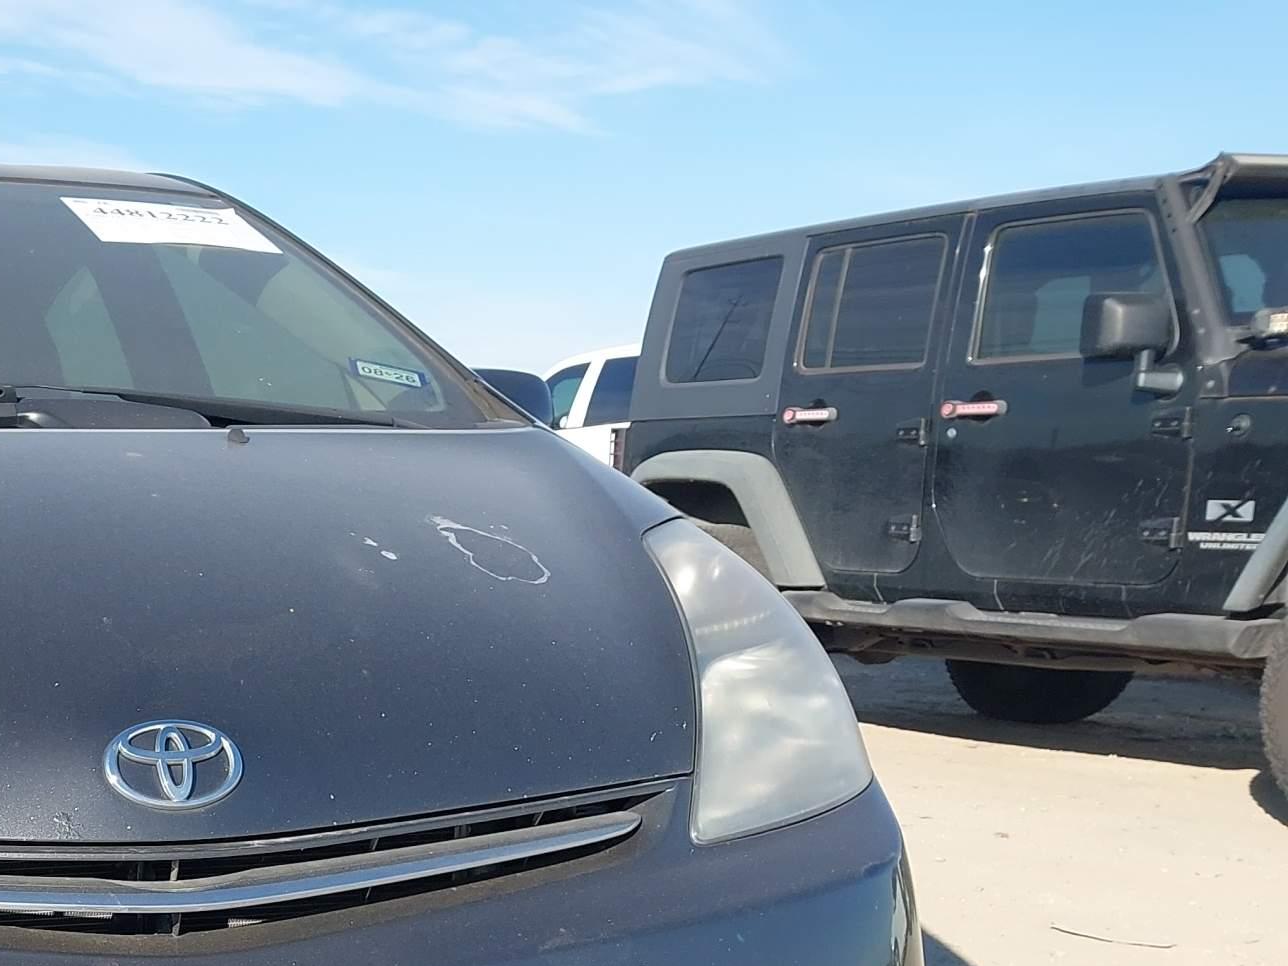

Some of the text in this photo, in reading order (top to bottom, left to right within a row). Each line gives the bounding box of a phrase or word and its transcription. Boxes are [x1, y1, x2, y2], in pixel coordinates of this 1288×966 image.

[92, 206, 230, 226] 44812222
[360, 365, 417, 384] 08-26
[1187, 531, 1266, 542] WRANGLE
[1199, 542, 1259, 551] UNLIMITE
